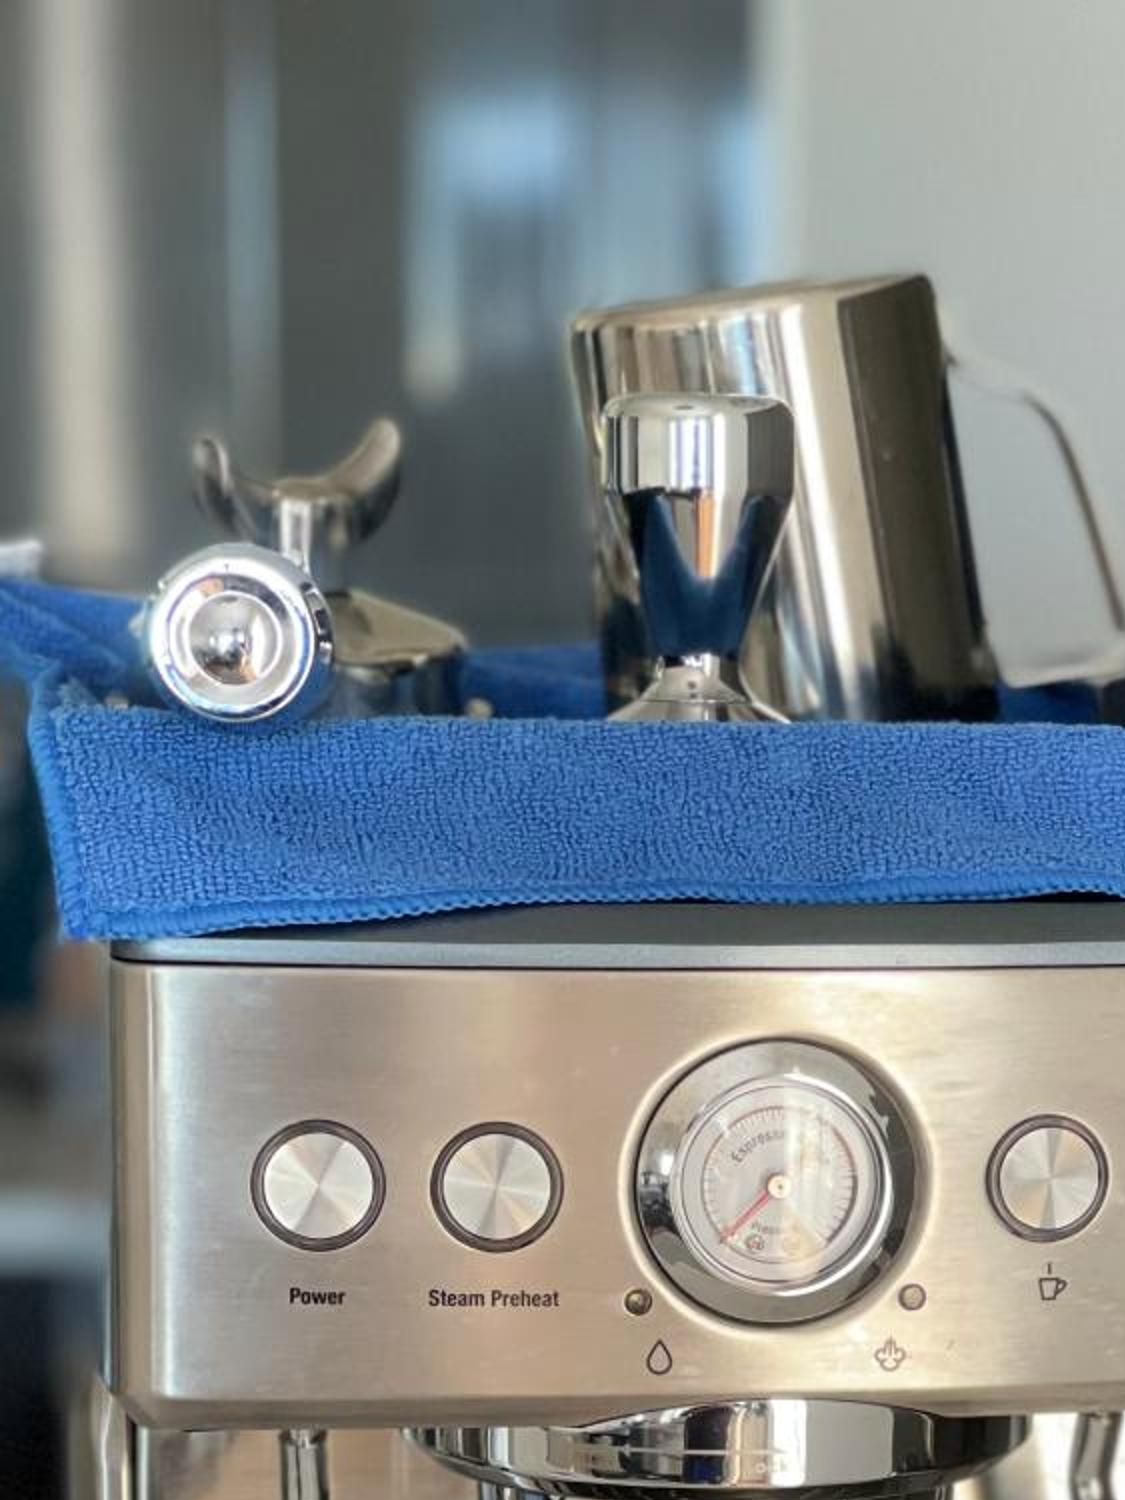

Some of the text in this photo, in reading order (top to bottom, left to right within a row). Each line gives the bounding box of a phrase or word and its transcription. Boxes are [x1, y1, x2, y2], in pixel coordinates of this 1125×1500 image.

[289, 1287, 346, 1305] Power
[428, 1289, 560, 1307] Steam Preheat
